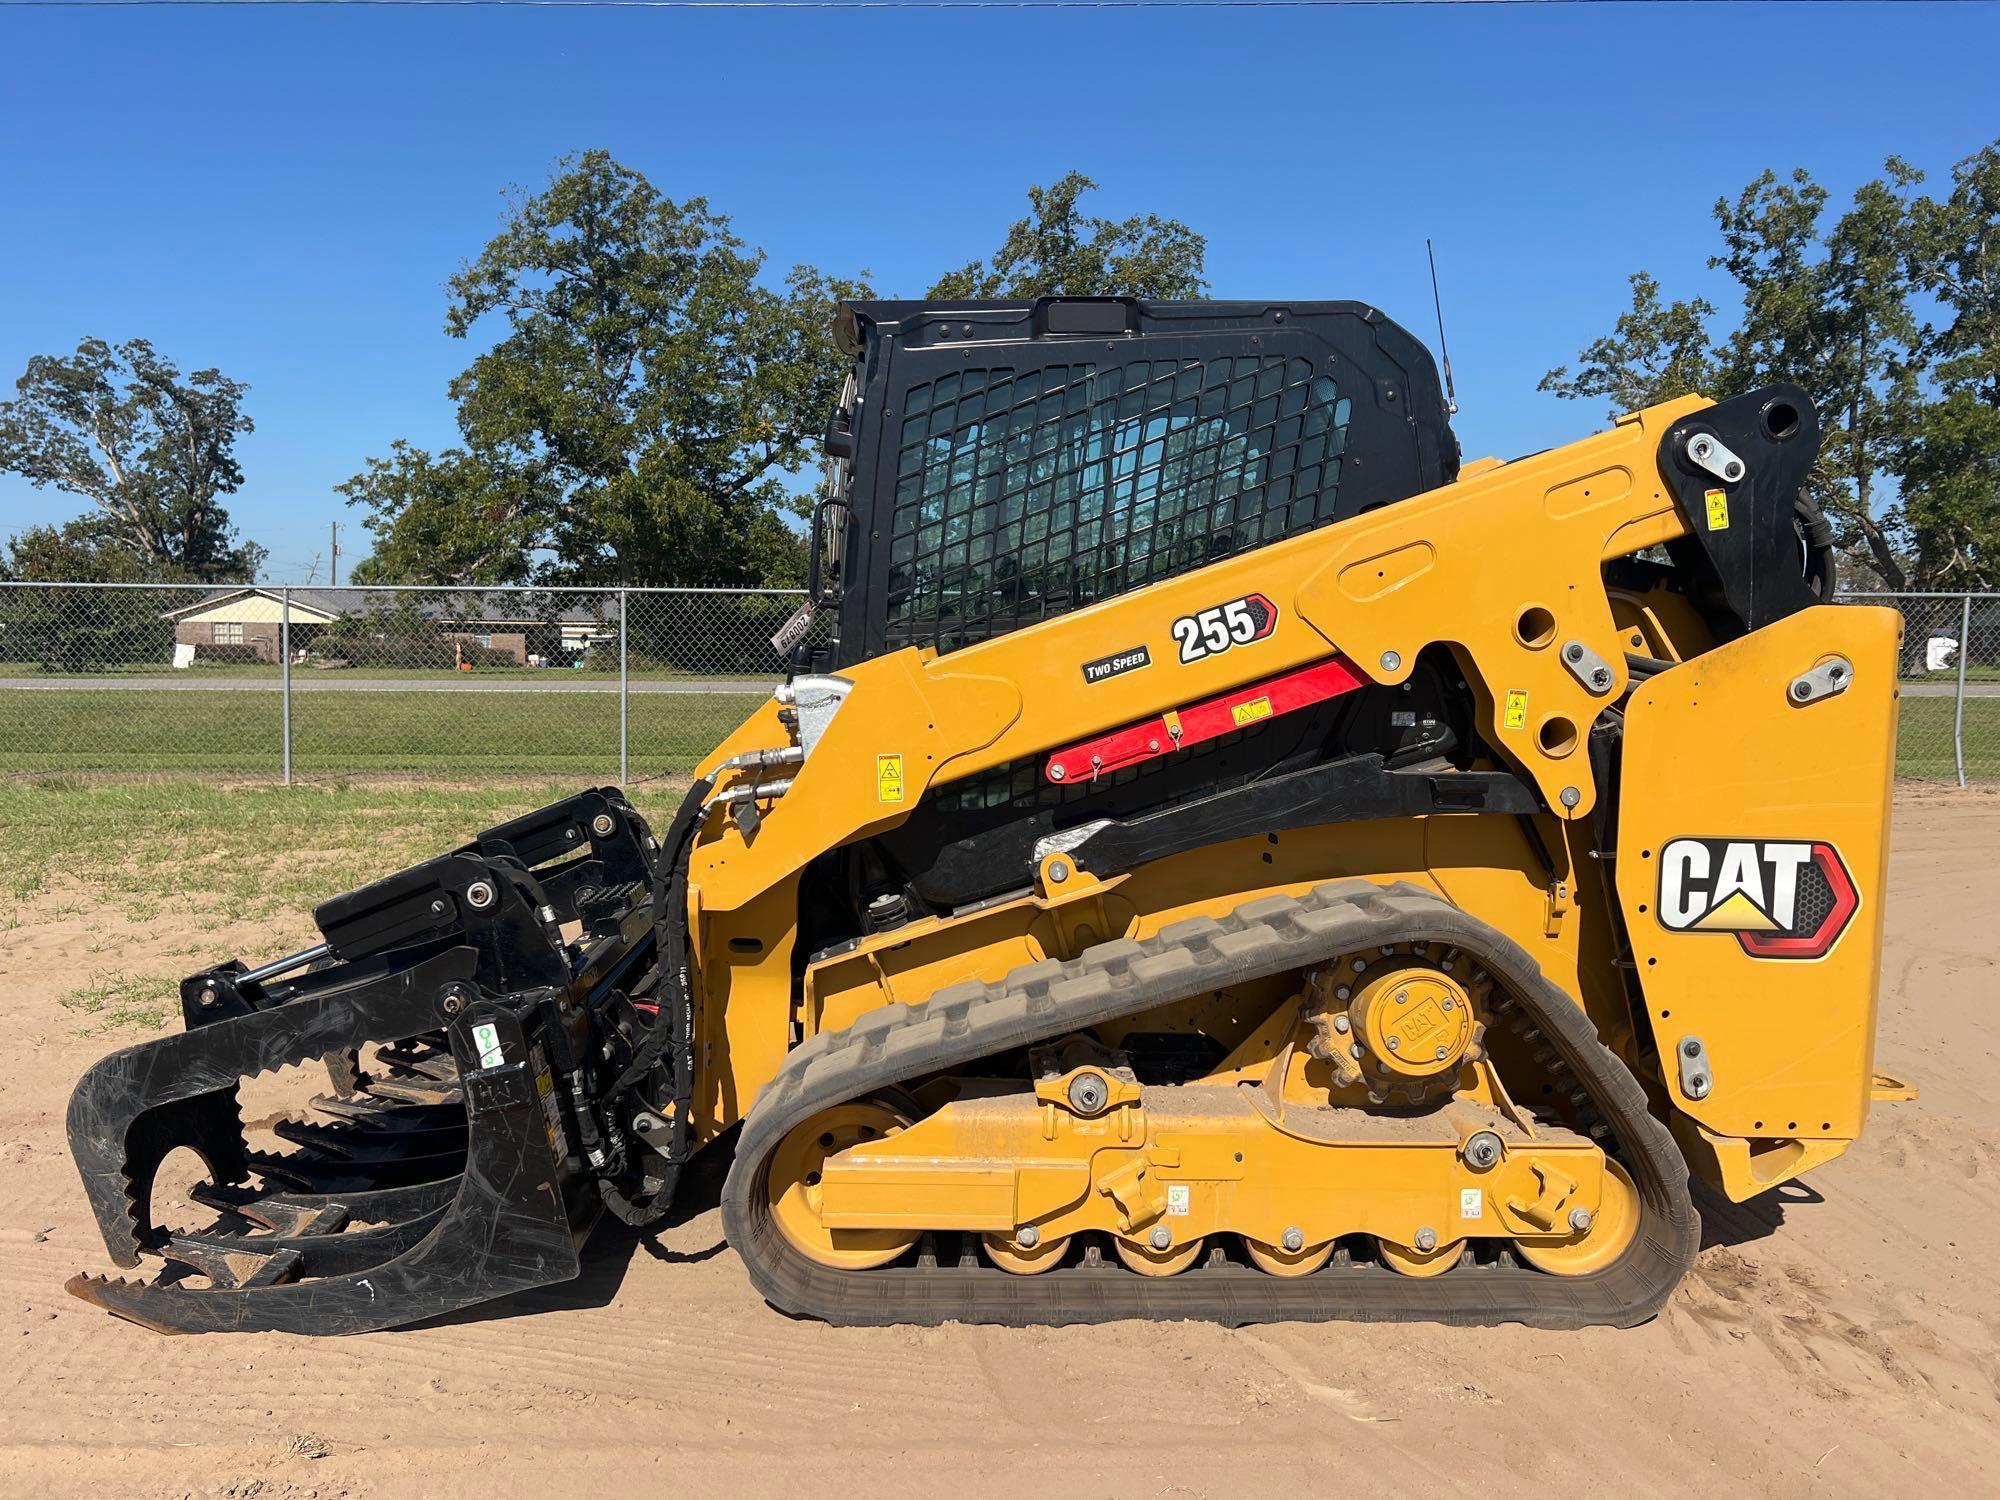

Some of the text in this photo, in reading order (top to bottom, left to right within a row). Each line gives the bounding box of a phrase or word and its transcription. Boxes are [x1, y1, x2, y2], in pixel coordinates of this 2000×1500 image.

[1173, 599, 1256, 662] 255
[1087, 652, 1145, 679] TWO SPEED
[1660, 840, 1812, 930] CAT
